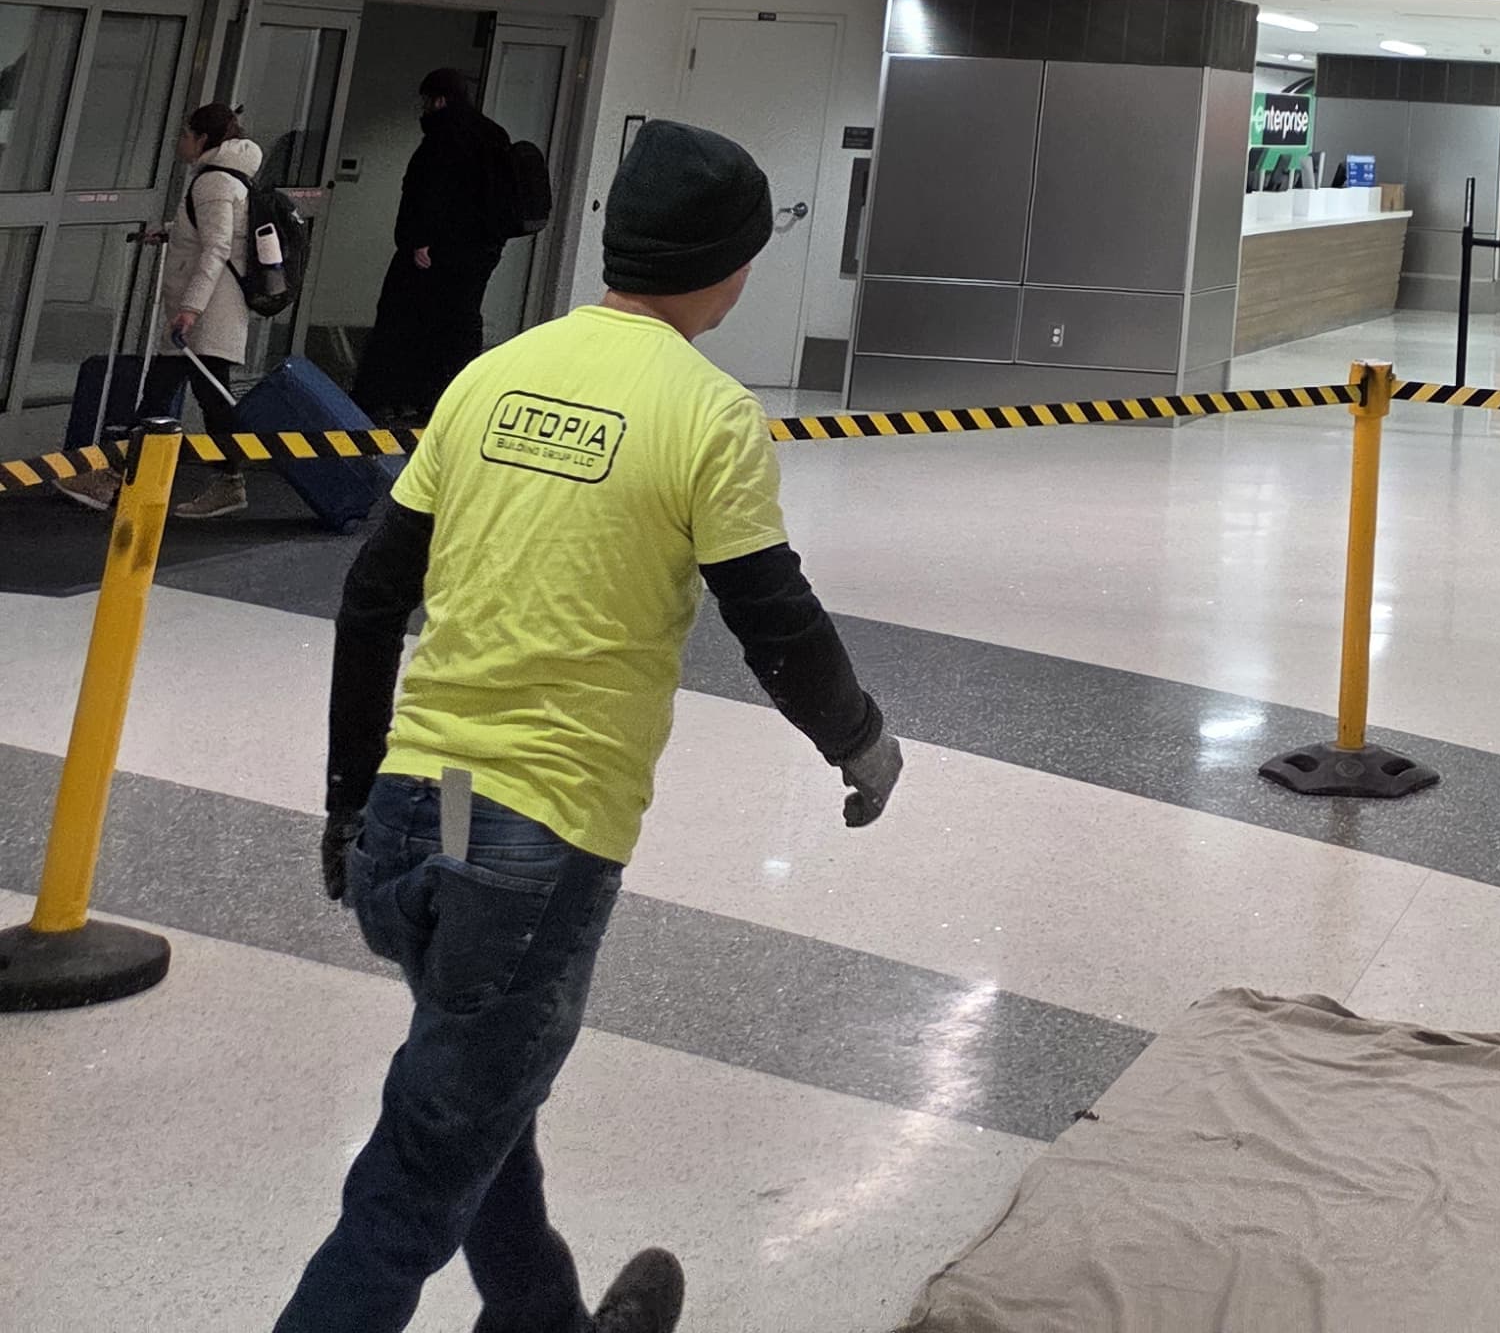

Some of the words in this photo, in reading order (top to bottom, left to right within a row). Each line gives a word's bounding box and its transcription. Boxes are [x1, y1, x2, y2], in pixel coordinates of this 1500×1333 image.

[1252, 103, 1309, 139] enterprise
[498, 403, 606, 451] UTOPIA
[574, 455, 595, 467] LLC
